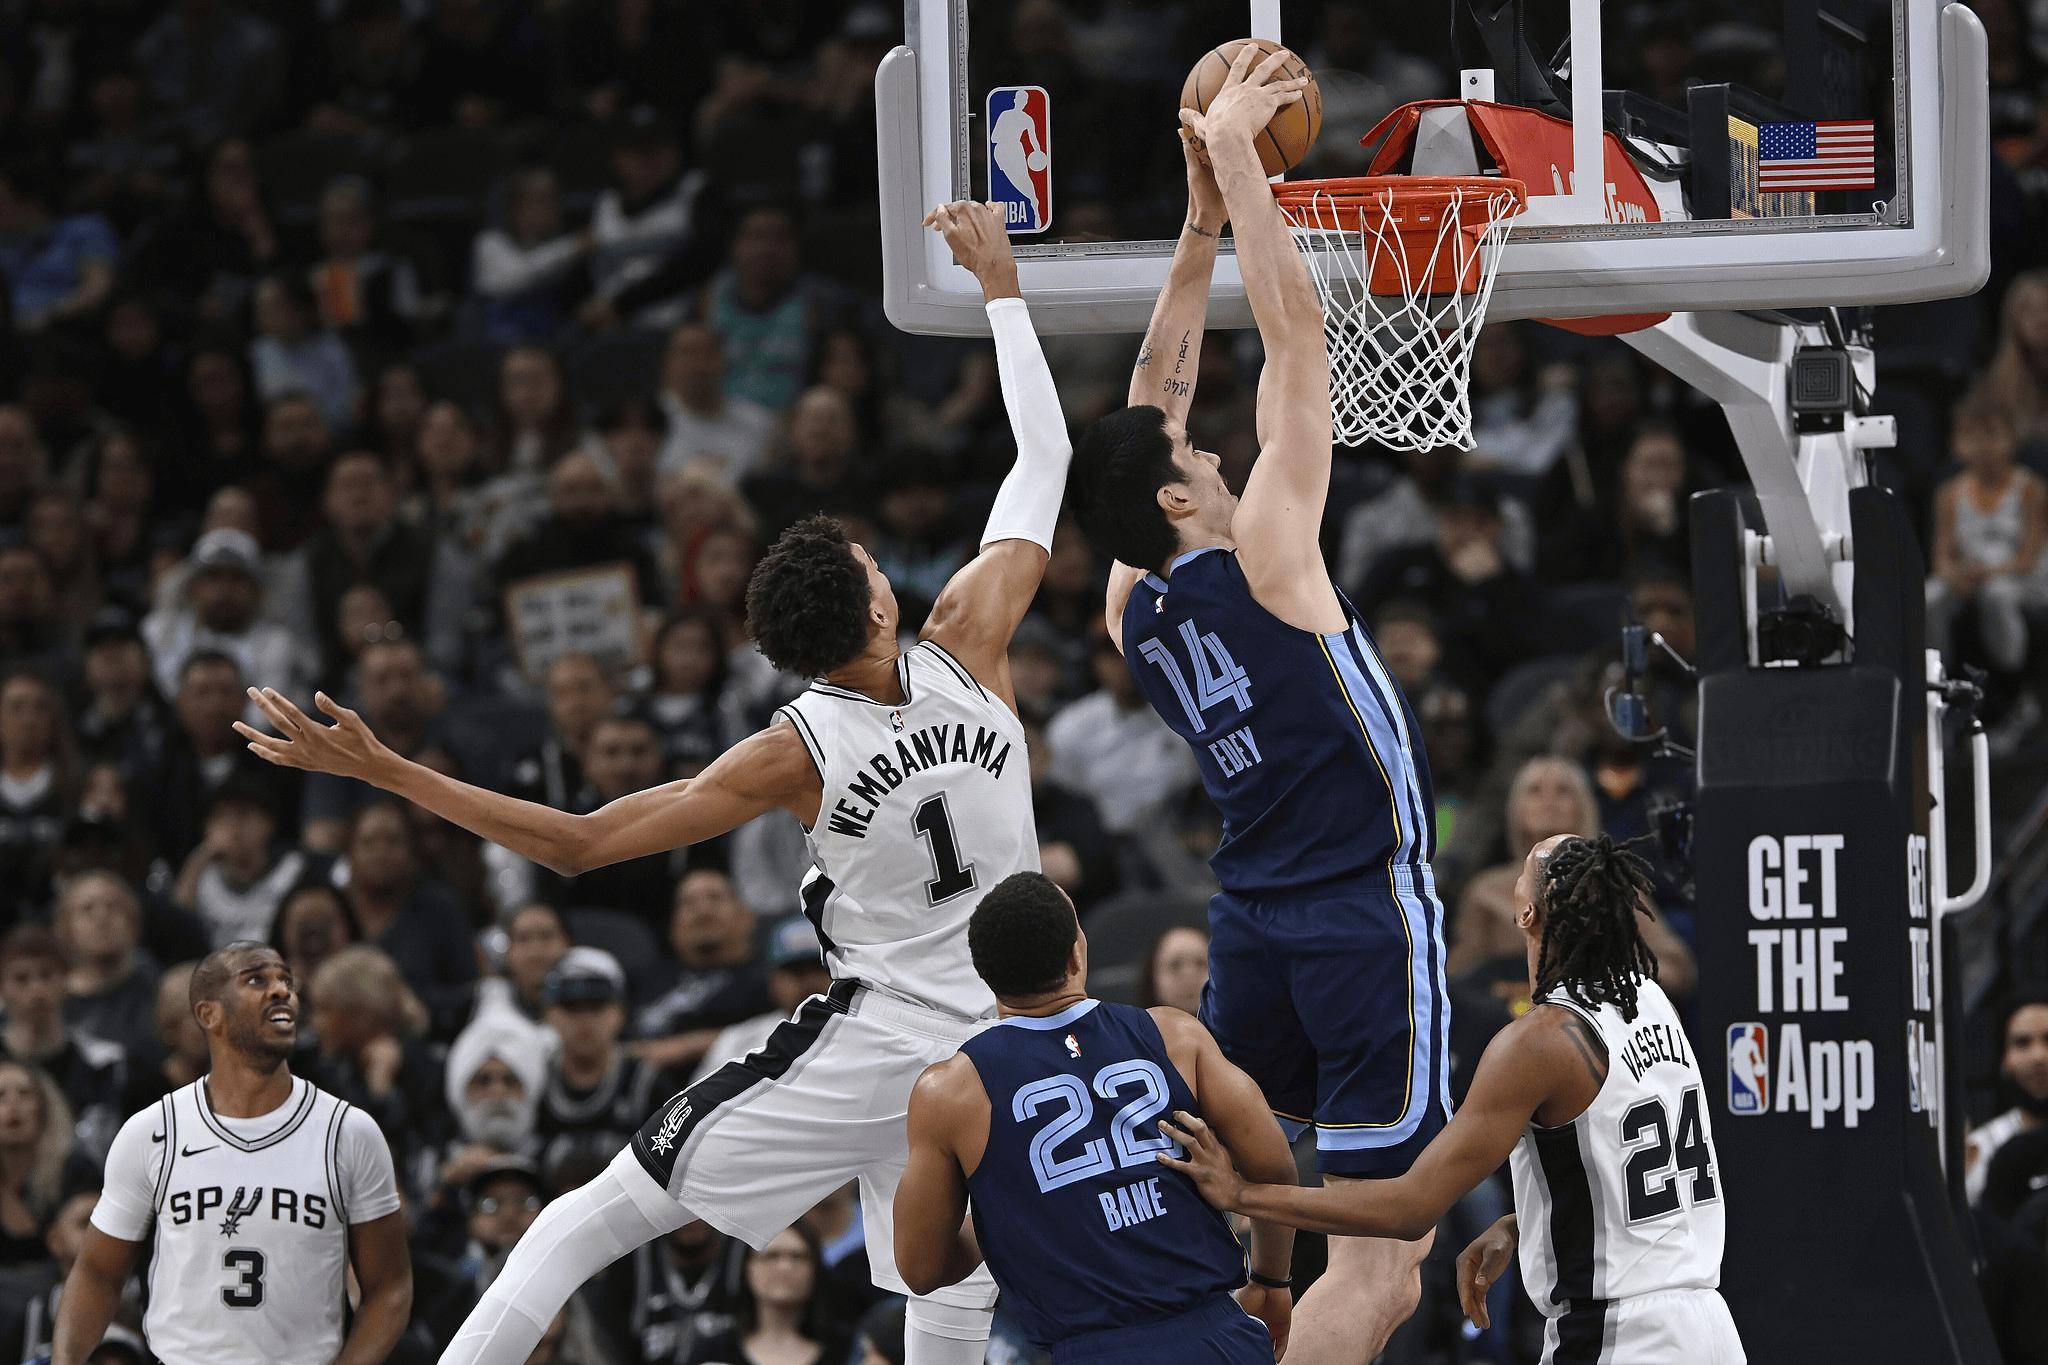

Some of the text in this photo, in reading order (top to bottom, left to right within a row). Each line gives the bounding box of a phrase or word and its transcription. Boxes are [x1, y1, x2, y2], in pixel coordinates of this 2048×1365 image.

[1004, 201, 1028, 223] BA
[1137, 618, 1253, 734] 14
[827, 723, 1012, 839] WEMBANYAMA
[1207, 726, 1263, 778] EDEY
[910, 790, 979, 909] 1
[1748, 834, 1845, 921] GET
[1748, 927, 1849, 1013] THE
[1620, 1023, 1690, 1083] VASSELL
[1775, 1023, 1875, 1129] App
[1012, 1058, 1183, 1193] 22
[1619, 1083, 1720, 1228] 24
[1098, 1177, 1168, 1232] BANE
[221, 1246, 267, 1311] 3
